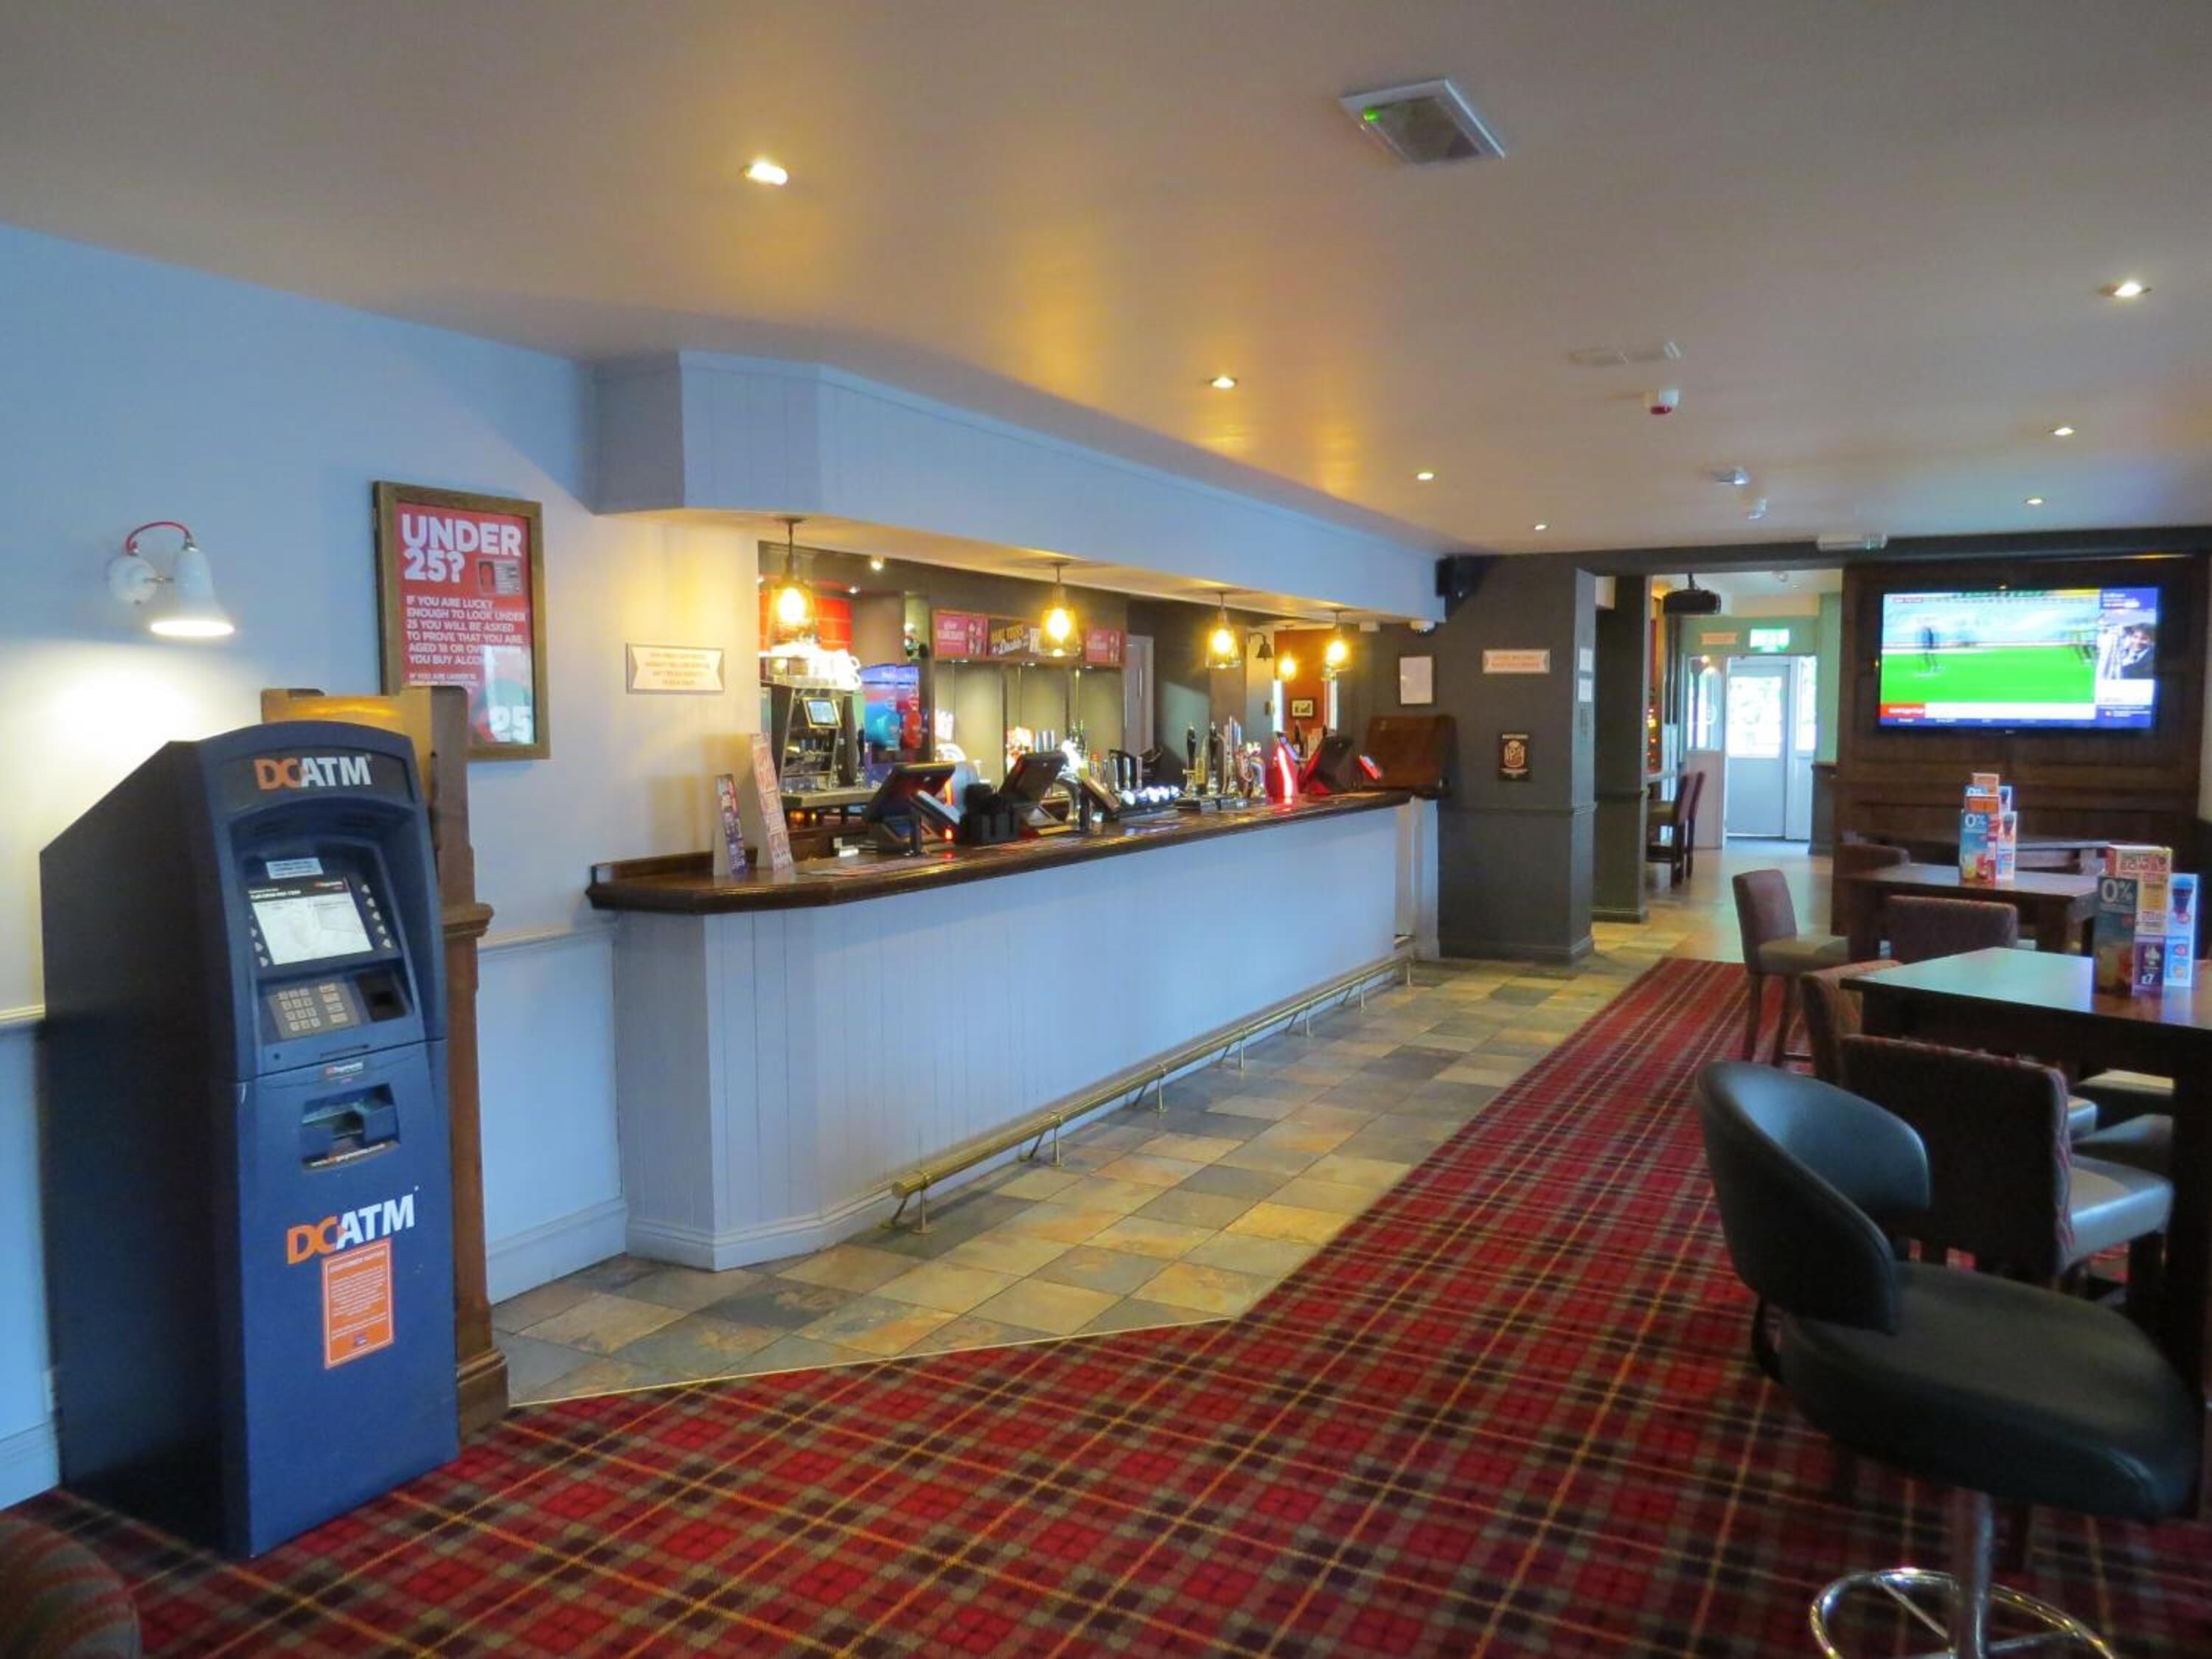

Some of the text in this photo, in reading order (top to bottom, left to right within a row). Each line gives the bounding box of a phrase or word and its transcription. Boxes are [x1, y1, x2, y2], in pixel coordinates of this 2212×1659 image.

[401, 514, 522, 557] UNDER
[404, 547, 465, 583] 25?
[407, 596, 493, 609] IF YOU ARE LUCKY
[407, 607, 526, 622] ENOUGH TO LOOK UNDER
[407, 619, 514, 633] 25 YOU WILL BE ASKED
[407, 630, 523, 644] TO PROVE THAT YOU ARE
[408, 642, 437, 653] AGED
[450, 644, 465, 653] OR
[408, 654, 431, 664] YOU
[432, 655, 452, 664] BUY
[254, 755, 372, 790] DCATM
[1964, 814, 1987, 828] 0%
[2101, 878, 2134, 902] 0%
[287, 1194, 416, 1265] DCATM
